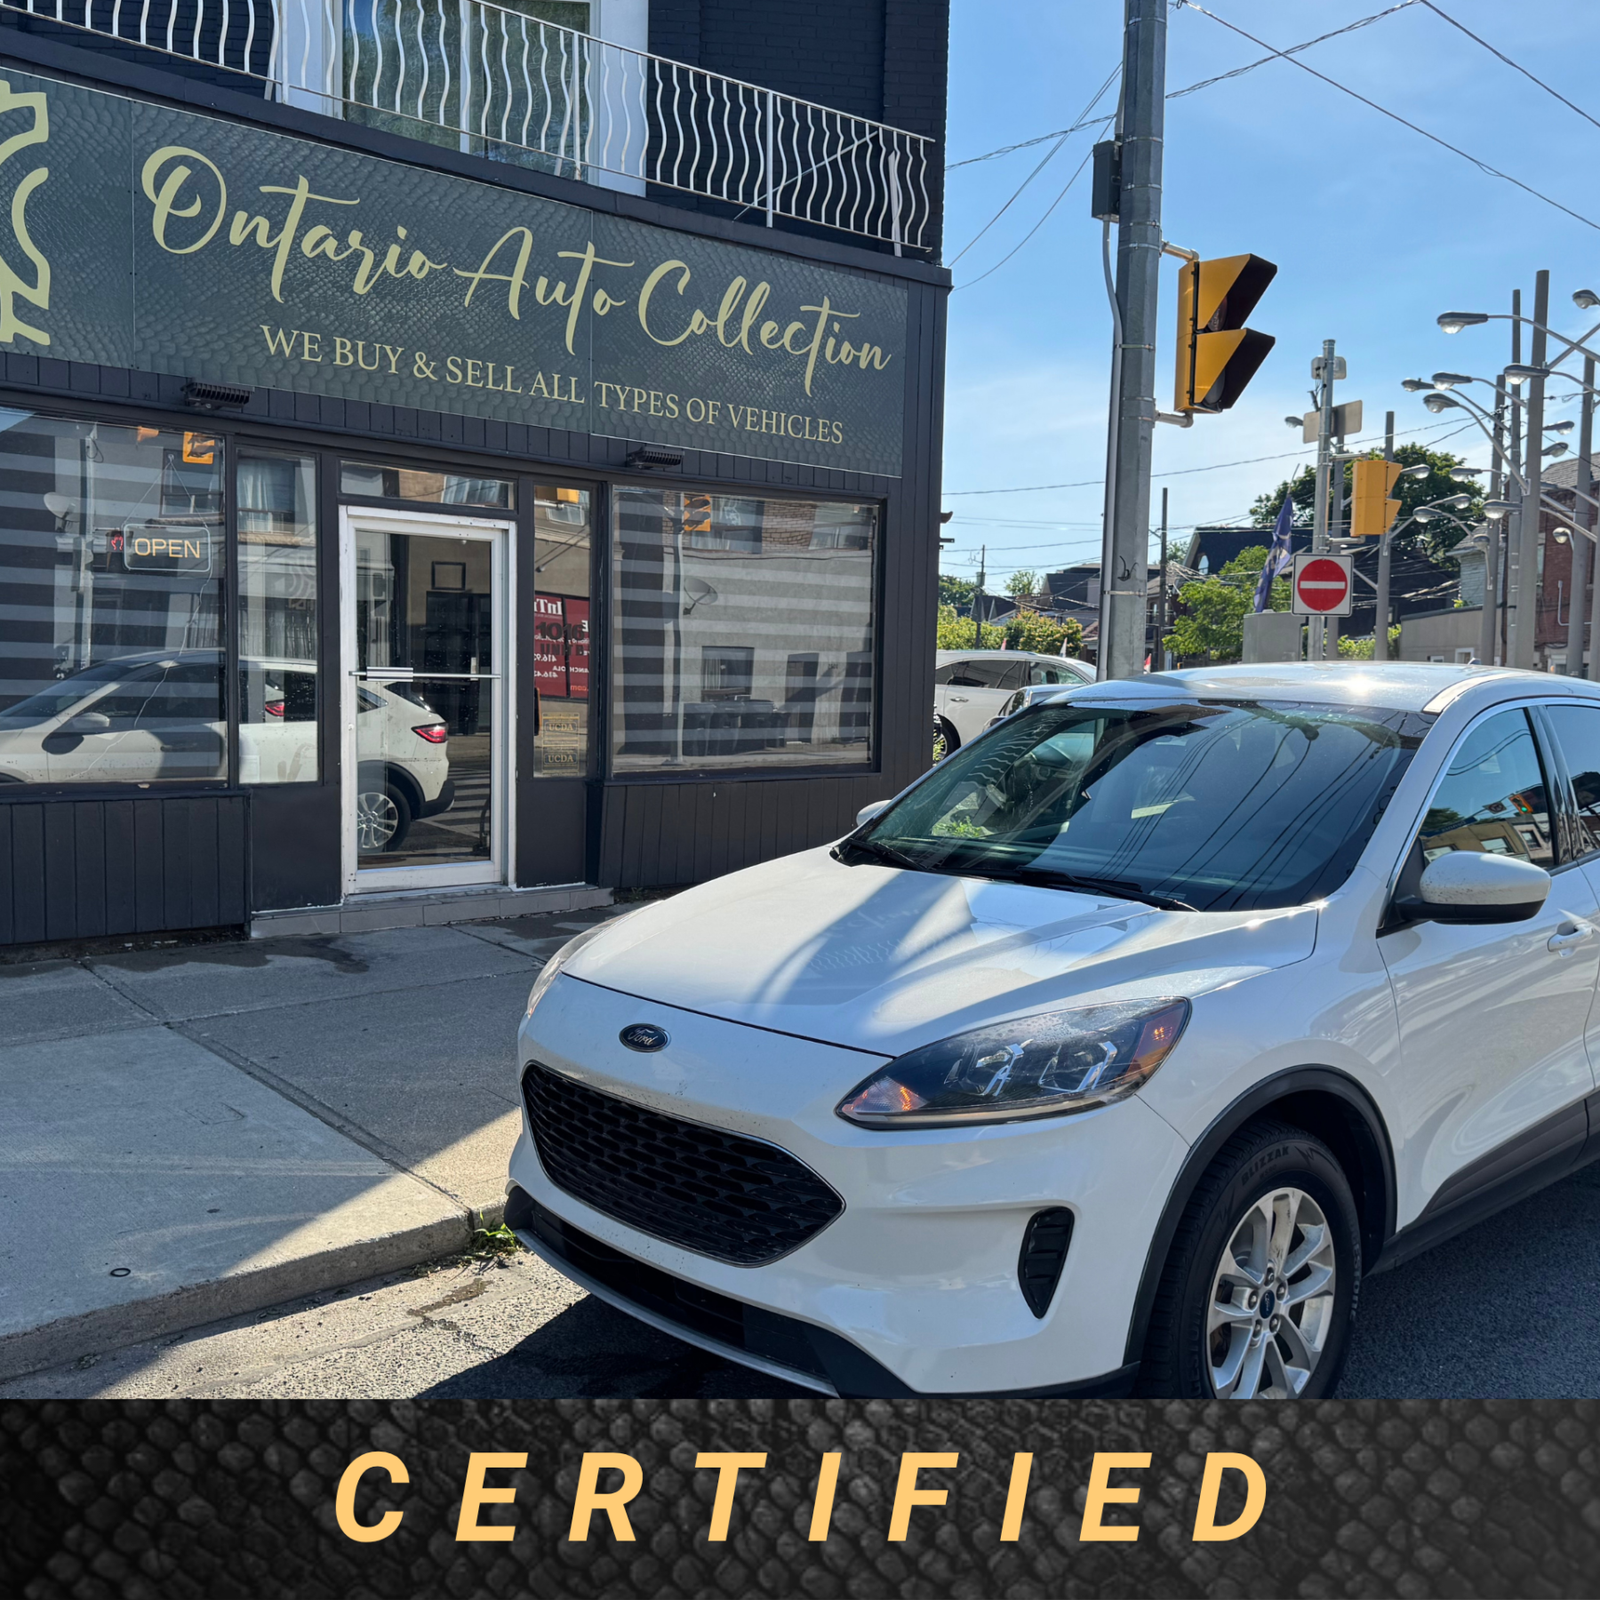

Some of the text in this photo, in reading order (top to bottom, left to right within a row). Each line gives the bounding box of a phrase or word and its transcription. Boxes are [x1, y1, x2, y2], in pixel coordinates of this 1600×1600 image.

[141, 146, 891, 396] Ontario Auto Collection
[260, 325, 843, 444] WE BUY & SELL ALL TYPES OF VEHICLES
[135, 538, 200, 558] OPEN
[536, 621, 586, 641] 1016
[548, 723, 574, 731] UCDA
[547, 753, 574, 763] UCDA
[1240, 1146, 1290, 1186] BLIZZAK
